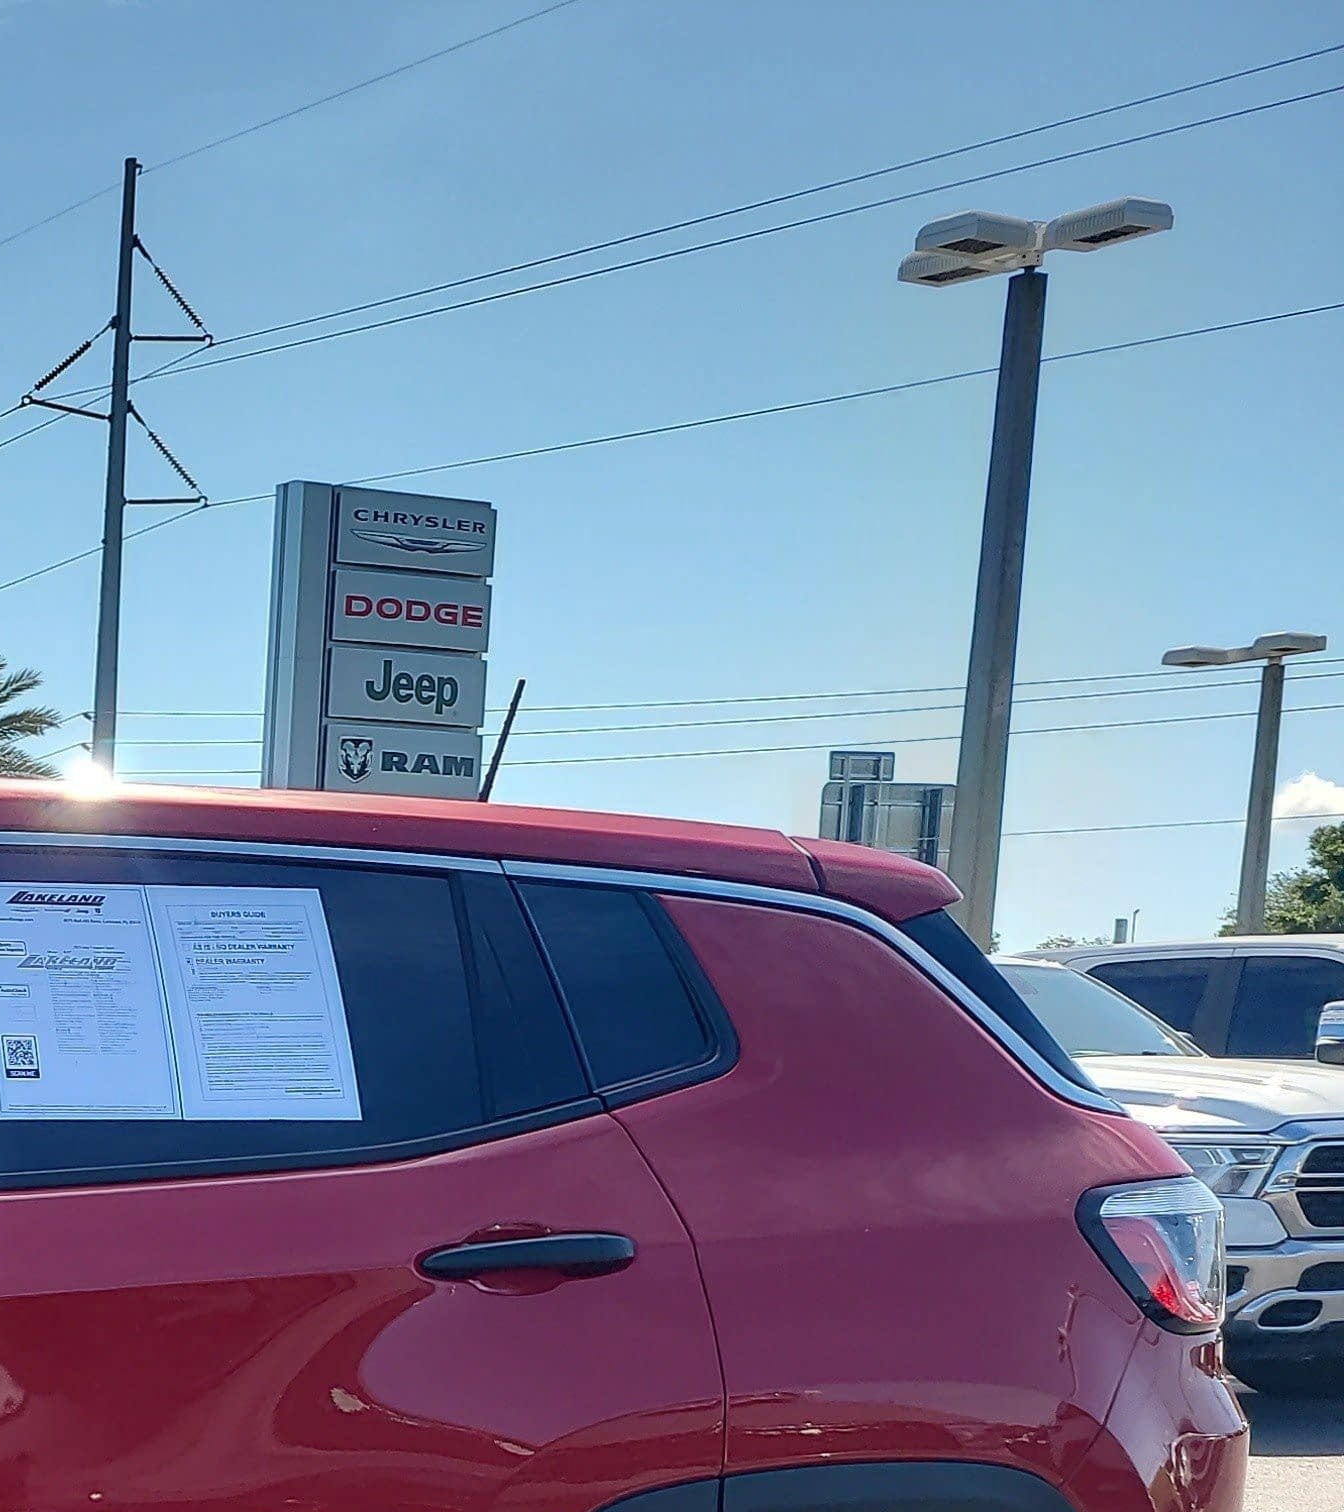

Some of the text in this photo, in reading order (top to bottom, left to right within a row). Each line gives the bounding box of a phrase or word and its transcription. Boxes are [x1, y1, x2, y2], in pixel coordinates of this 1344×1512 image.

[353, 508, 486, 534] CHRYSLER
[344, 594, 484, 628] DODGE
[365, 659, 458, 715] Jeep
[380, 750, 475, 778] RAM
[6, 891, 105, 906] LAKELAND
